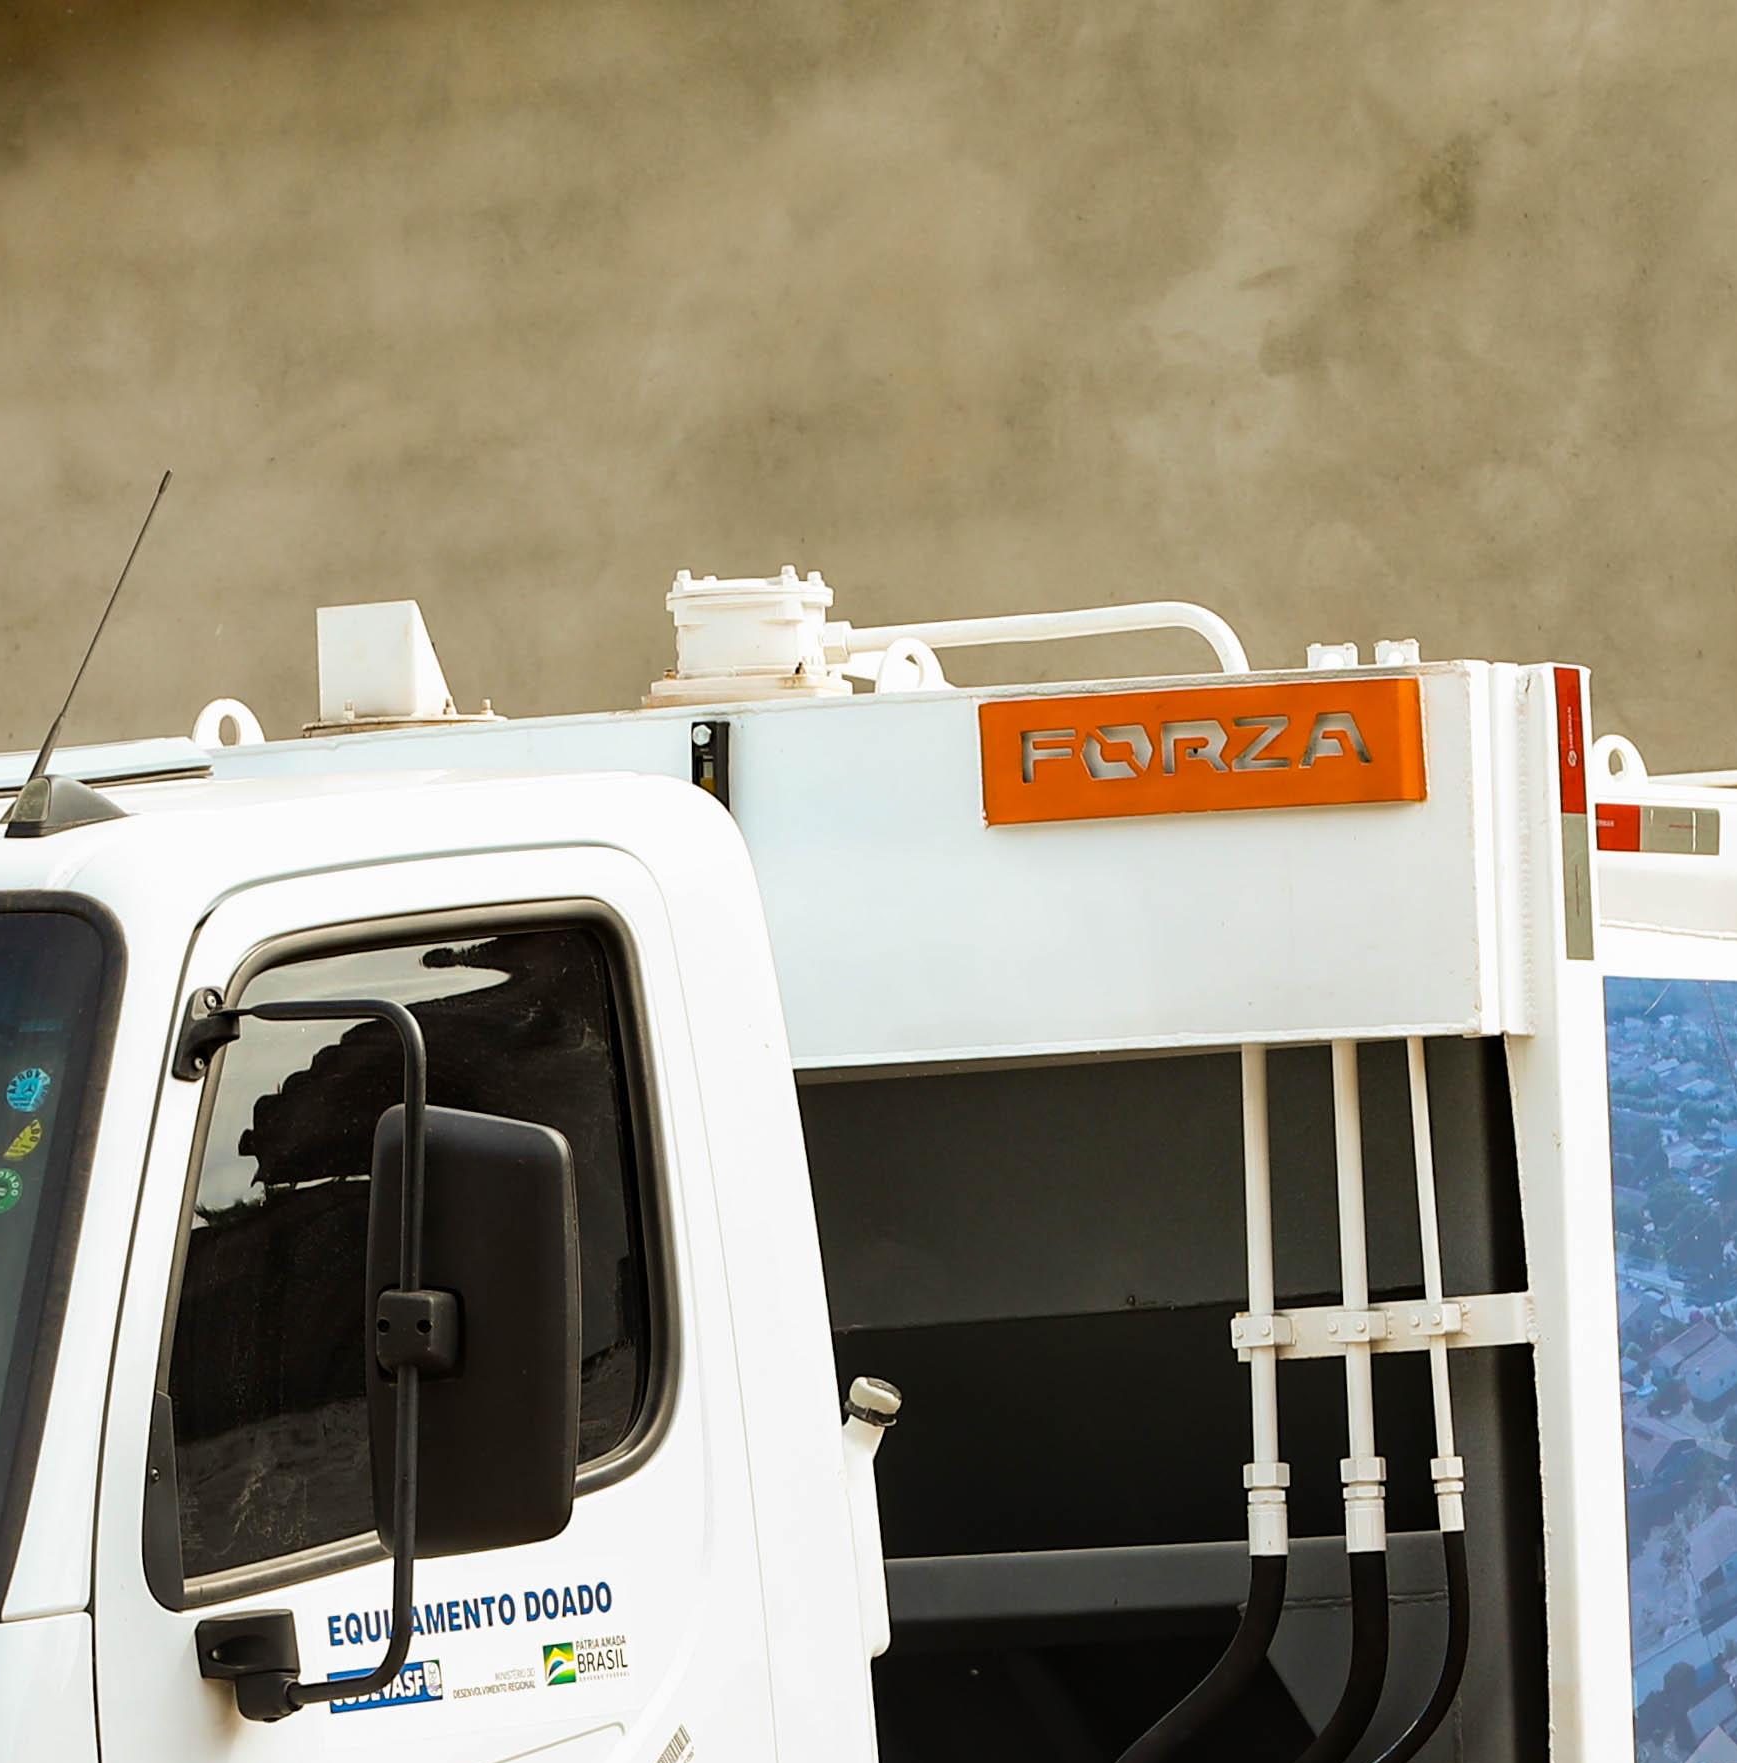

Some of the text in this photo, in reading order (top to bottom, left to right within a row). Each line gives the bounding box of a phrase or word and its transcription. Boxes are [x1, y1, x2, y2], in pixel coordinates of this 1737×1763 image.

[1019, 711, 1372, 784] FORZA
[327, 1581, 613, 1647] EQUIAMENTO DOADO
[577, 1648, 629, 1674] BRASIL
